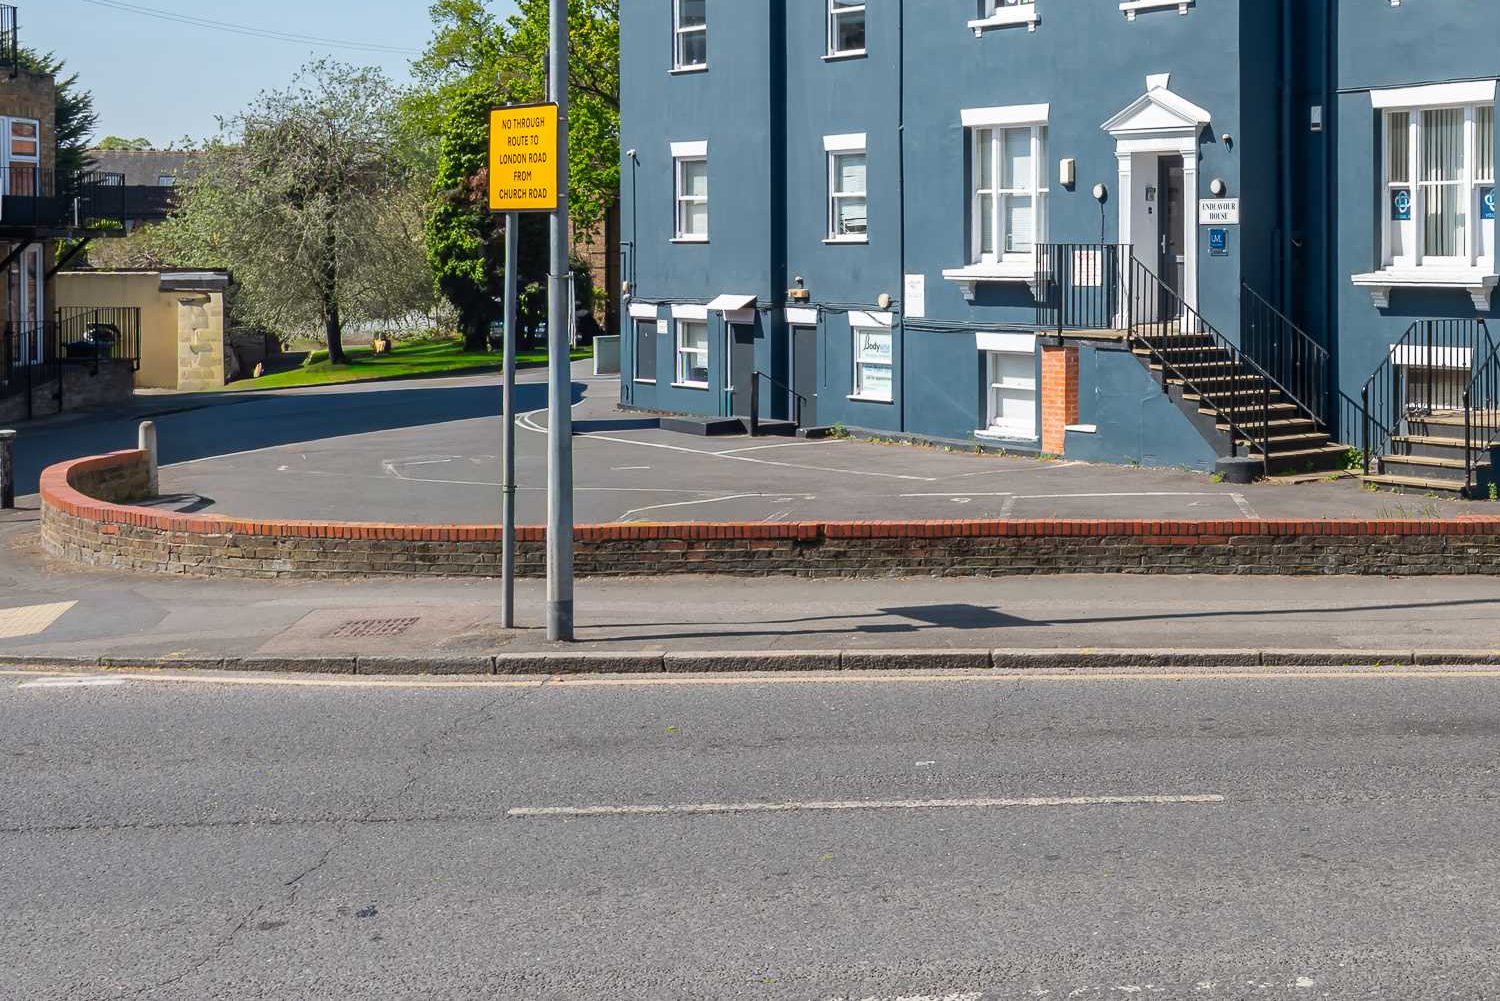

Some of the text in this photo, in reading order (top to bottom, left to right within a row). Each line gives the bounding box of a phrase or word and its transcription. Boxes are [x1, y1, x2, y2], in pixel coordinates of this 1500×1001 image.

[502, 117, 545, 129] NO THROUGH
[508, 135, 539, 146] ROUTE TO
[500, 152, 547, 165] LONDON ROAD
[513, 170, 532, 181] FROM
[499, 188, 547, 200] CHURCH ROAD
[1202, 202, 1236, 211] ENDEAVOUR
[1209, 212, 1227, 220] HOUSE
